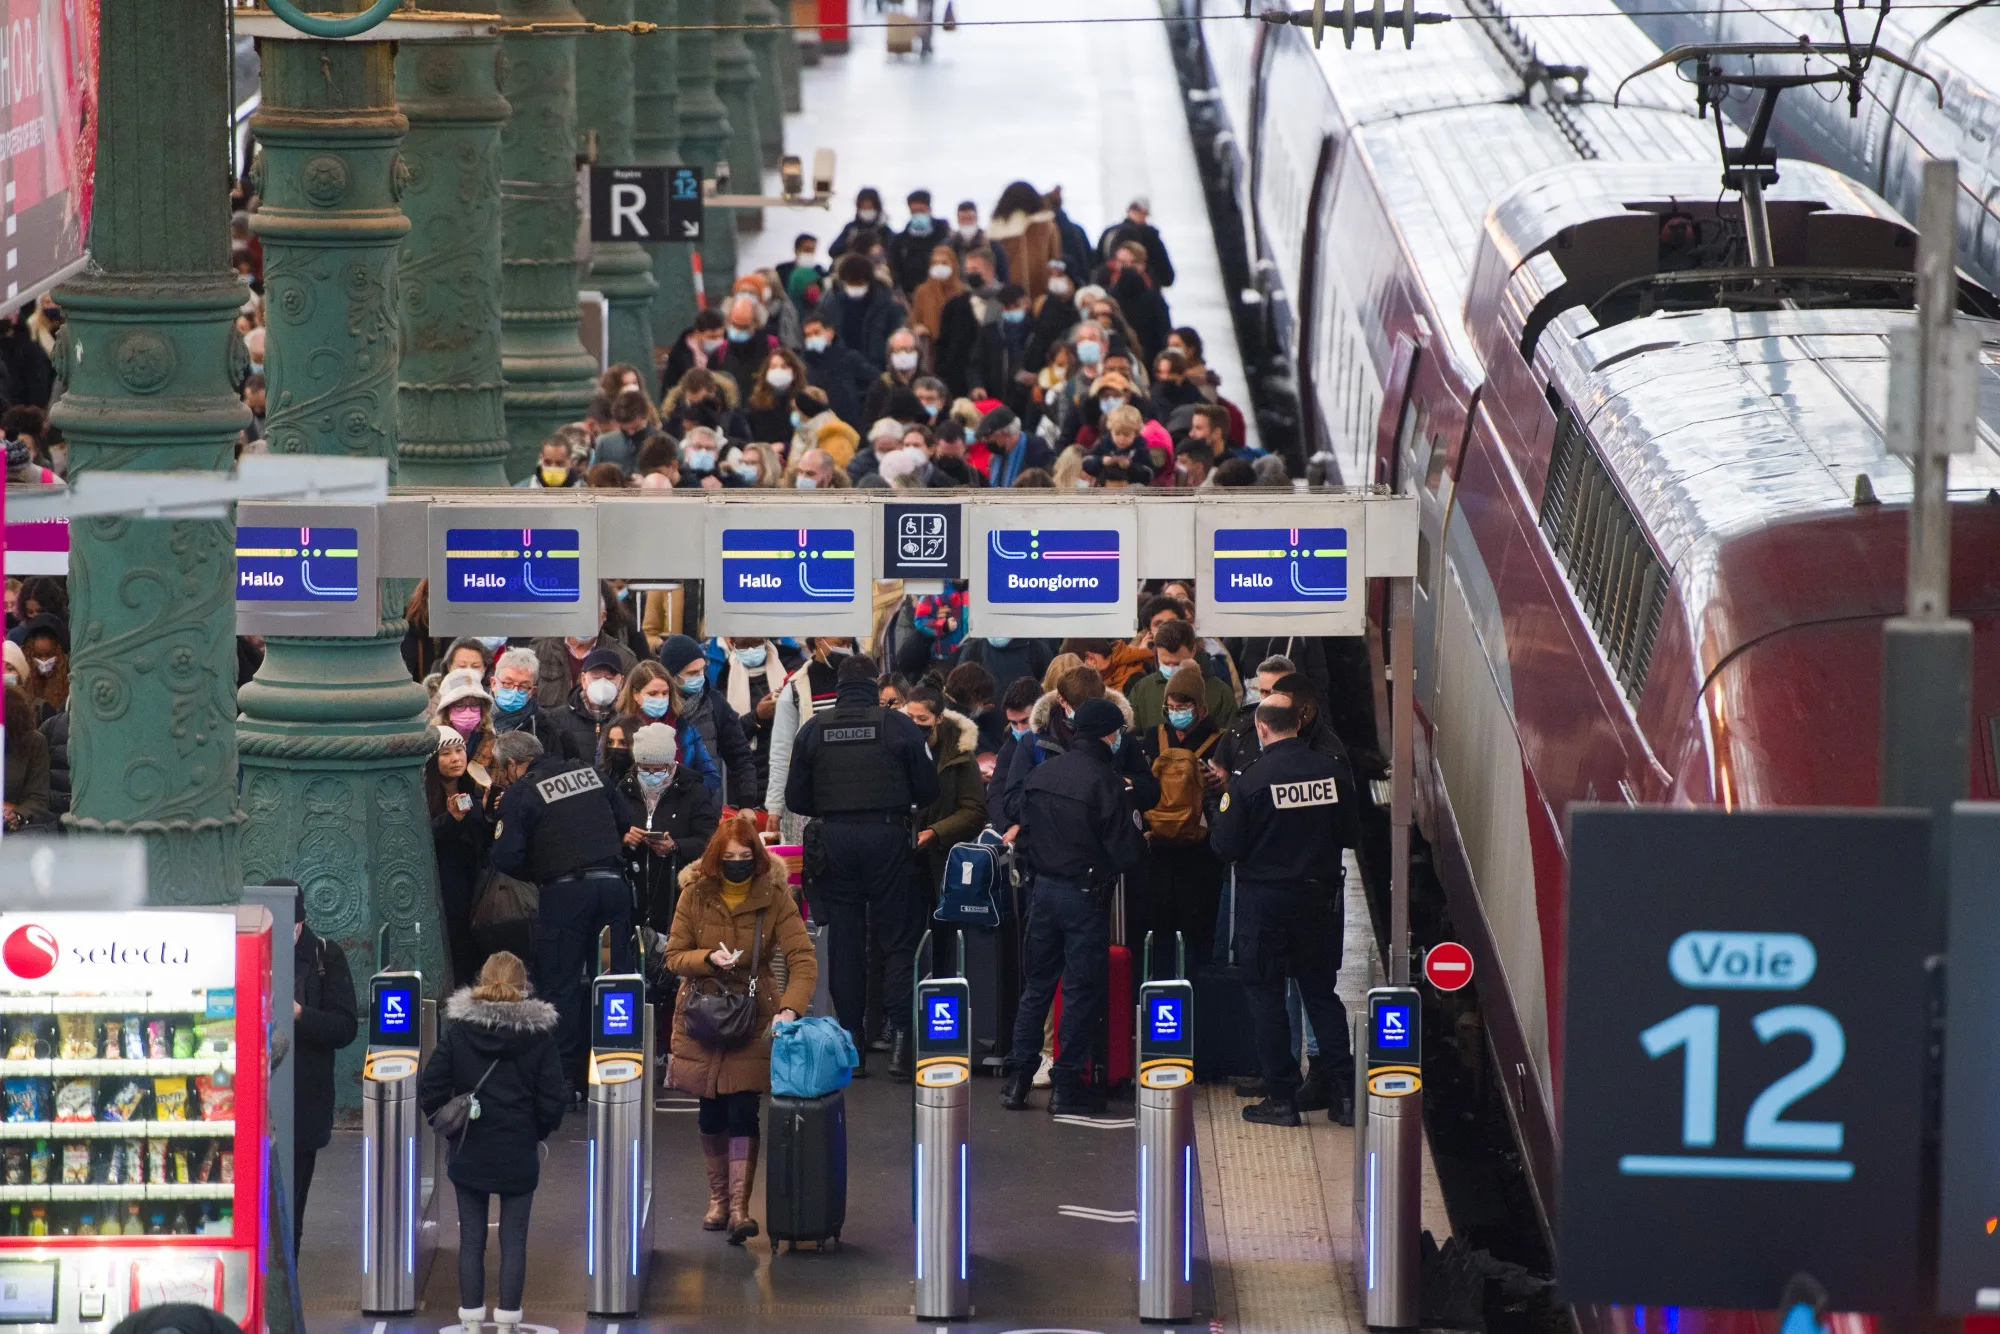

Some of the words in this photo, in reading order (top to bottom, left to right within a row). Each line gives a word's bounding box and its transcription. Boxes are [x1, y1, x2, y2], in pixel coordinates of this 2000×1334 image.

[672, 178, 698, 194] 12
[611, 183, 650, 236] R
[240, 571, 284, 587] Hallo
[463, 573, 506, 588] Hallo
[737, 572, 782, 588] Hallo
[1007, 572, 1100, 592] Buongiorno
[1230, 572, 1274, 588] Hallo
[826, 727, 873, 742] POLICE
[540, 770, 599, 801] POLICE
[1276, 781, 1334, 806] POLICE
[72, 941, 189, 965] selecta
[1689, 940, 1796, 981] Voie
[1638, 1003, 1847, 1152] 12
